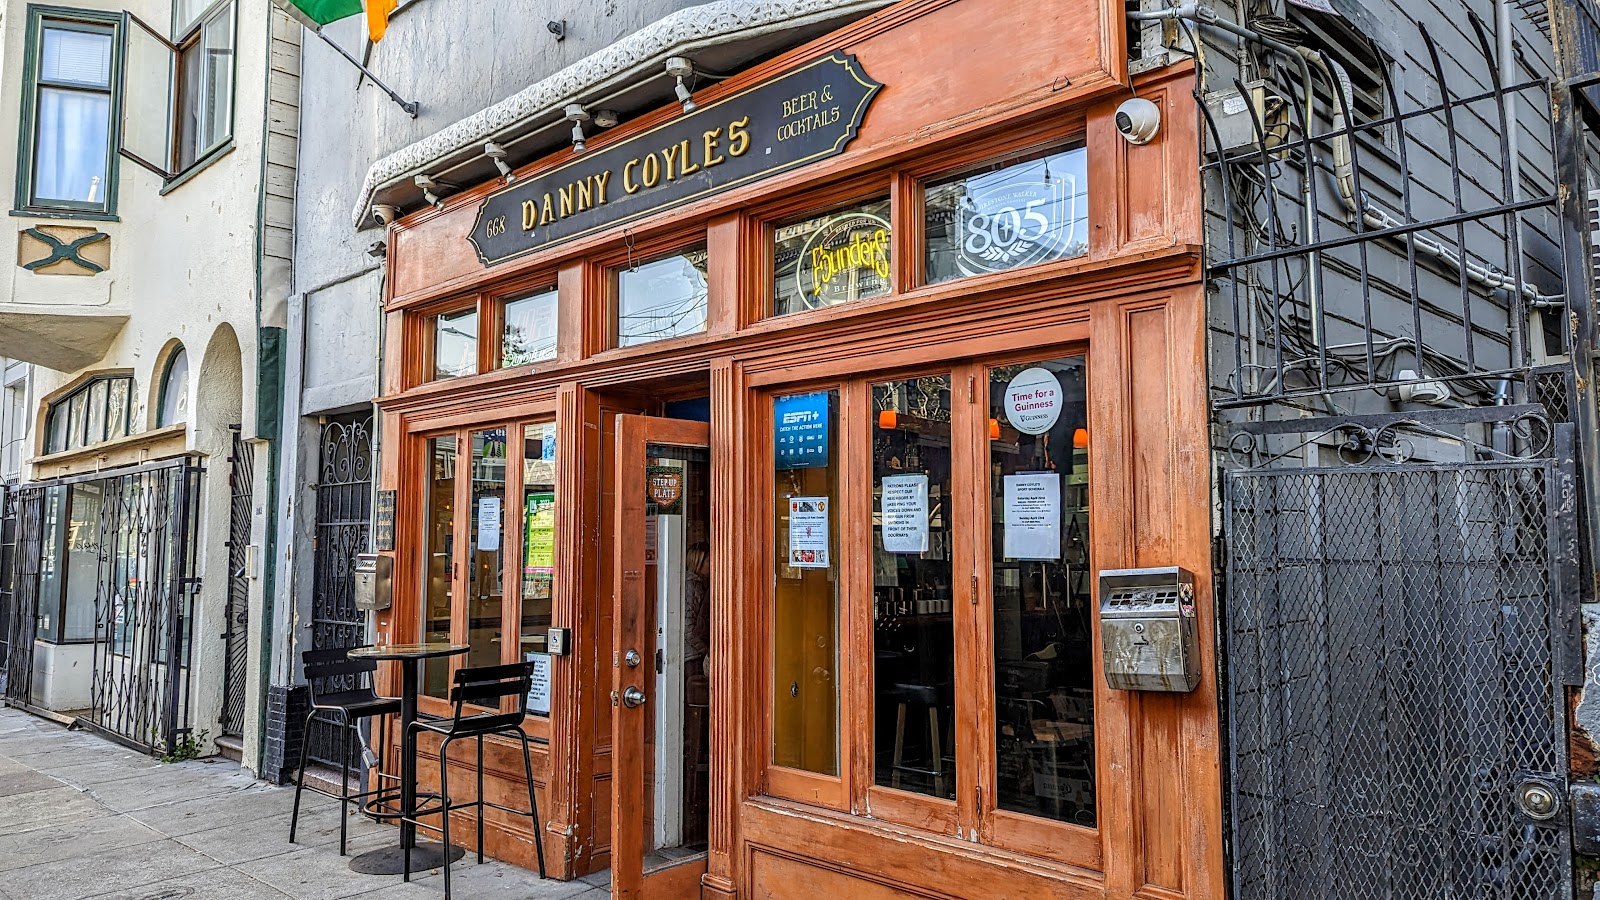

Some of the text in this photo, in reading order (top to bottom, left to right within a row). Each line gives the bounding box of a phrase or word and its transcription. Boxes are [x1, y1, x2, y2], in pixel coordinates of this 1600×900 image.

[782, 85, 833, 118] BEER &
[777, 105, 840, 141] COCKTAILS
[522, 115, 750, 231] DANNY COYLES
[486, 215, 506, 238] 668
[966, 197, 1049, 254] 805
[812, 229, 889, 296] Founders
[1012, 393, 1033, 402] Time
[1035, 389, 1047, 398] for
[1015, 400, 1053, 411] Guinness
[783, 411, 819, 424] ESPN+
[653, 478, 668, 486] STEP
[654, 489, 676, 498] PLATE
